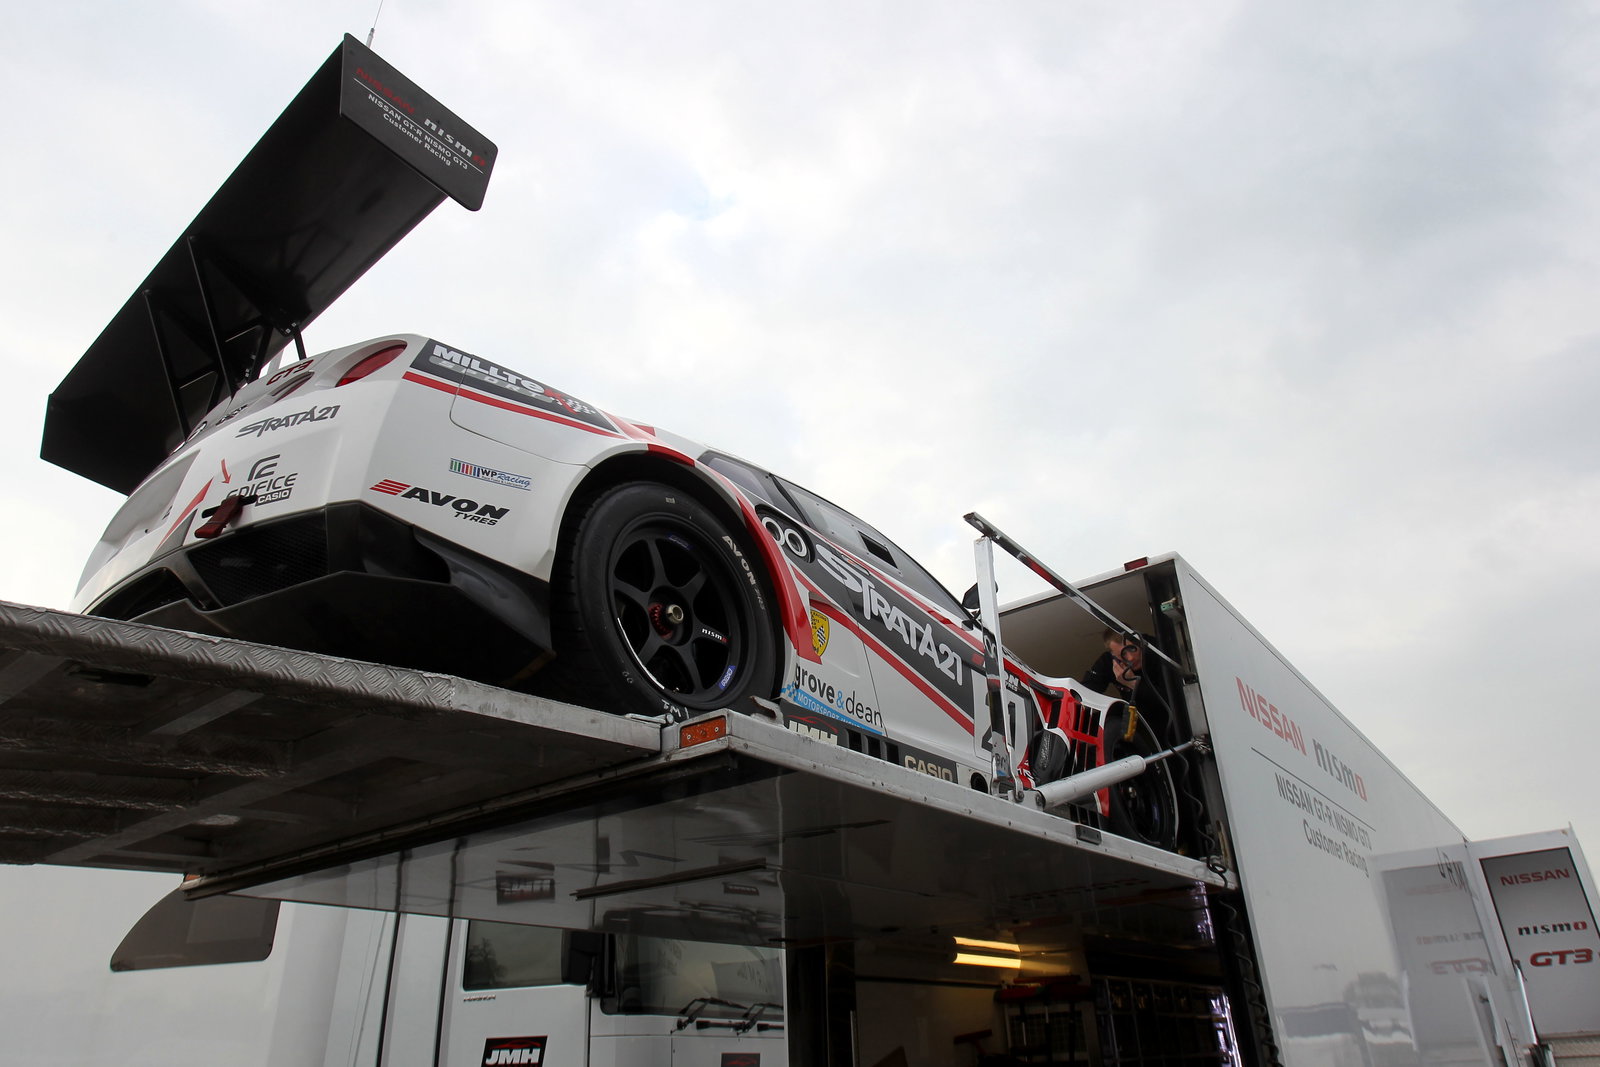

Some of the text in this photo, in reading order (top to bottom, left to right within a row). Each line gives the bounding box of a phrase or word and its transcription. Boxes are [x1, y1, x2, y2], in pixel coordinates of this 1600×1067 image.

[355, 67, 415, 115] NISSAN
[368, 94, 469, 170] NISSAN GT-R NISMO GT3
[383, 113, 451, 167] Customer Racing
[424, 118, 486, 167] nismo
[266, 359, 314, 386] GT3
[235, 405, 341, 438] STRATA21
[257, 490, 290, 502] CASIO
[401, 487, 510, 520] AVON
[454, 511, 498, 526] TYRES
[722, 535, 757, 585] AVON
[815, 544, 963, 686] STRATA21
[1236, 676, 1307, 756] NISSAN
[1312, 738, 1367, 801] nismo
[1275, 772, 1315, 816] NISSAN
[1303, 818, 1344, 861] Customer
[1501, 869, 1570, 886] NISSAN
[1518, 921, 1588, 935] nismo
[1530, 948, 1593, 967] GT3
[485, 1048, 540, 1065] JMH
